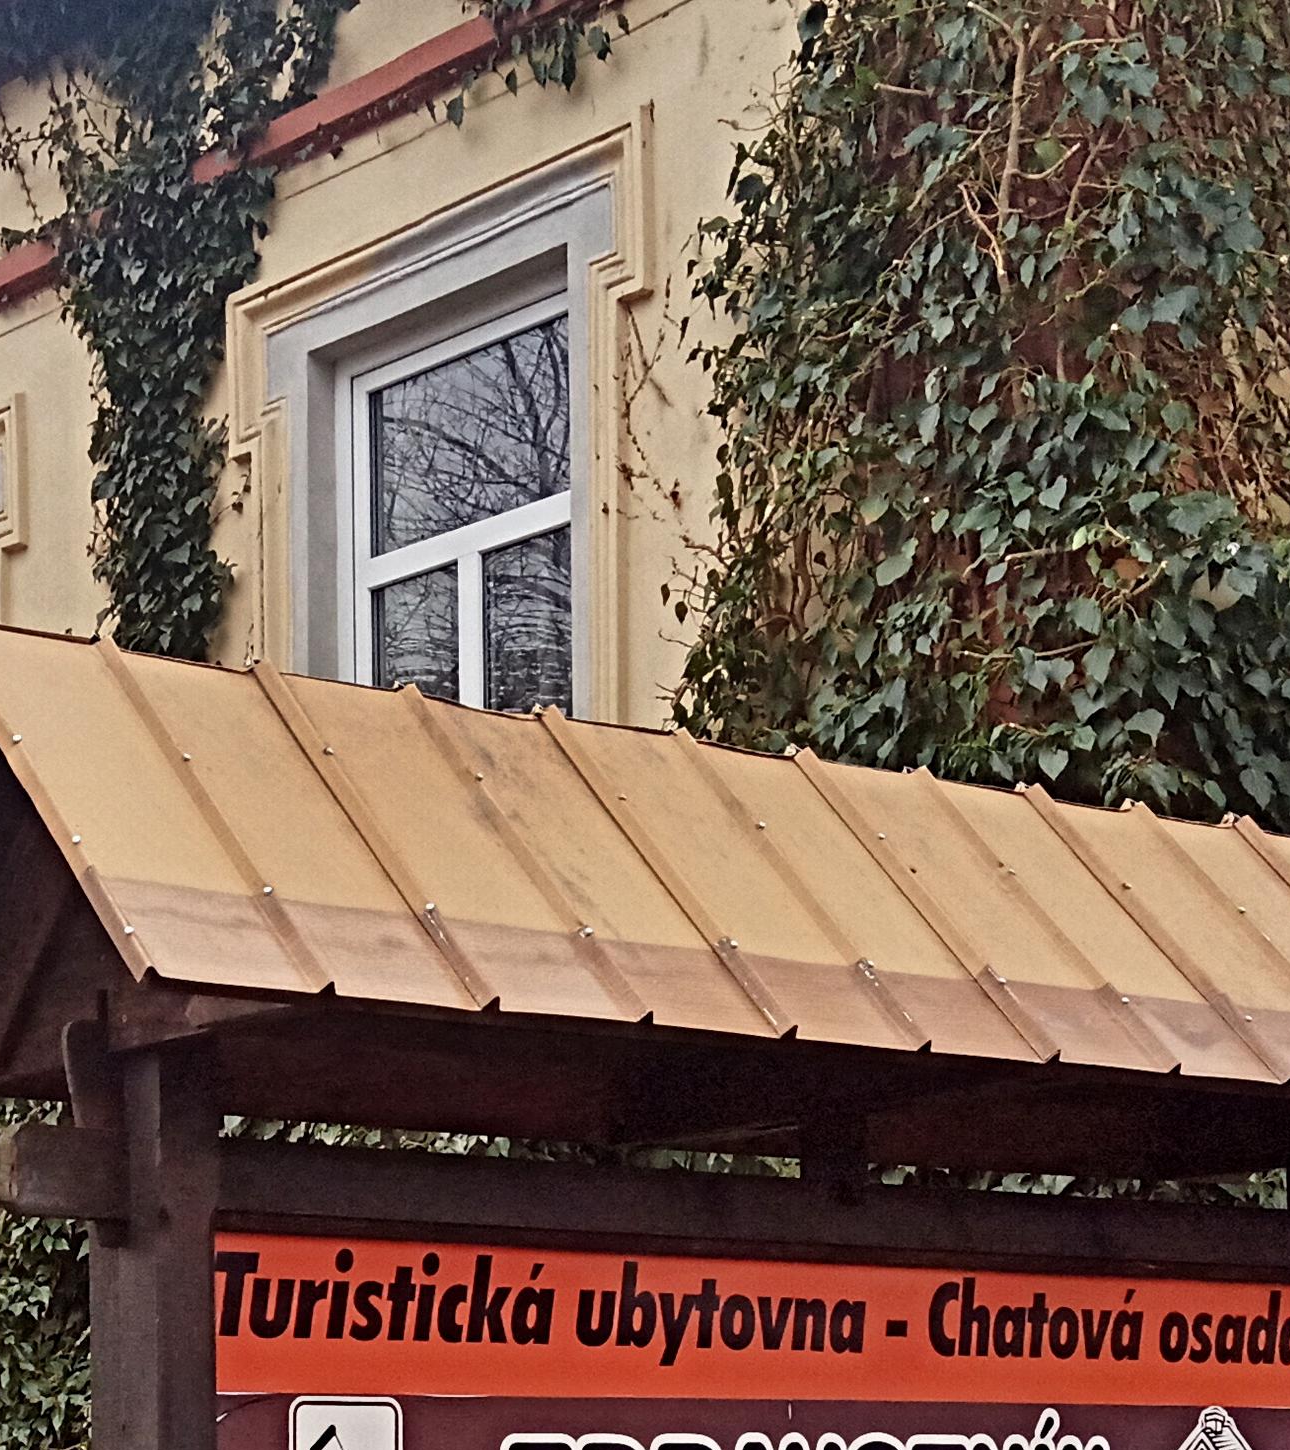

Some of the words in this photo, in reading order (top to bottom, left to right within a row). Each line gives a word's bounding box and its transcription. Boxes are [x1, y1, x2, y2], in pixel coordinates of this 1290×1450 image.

[215, 1248, 555, 1344] Turistická
[576, 1261, 866, 1366] ubytovna
[928, 1277, 1144, 1361] Chatová
